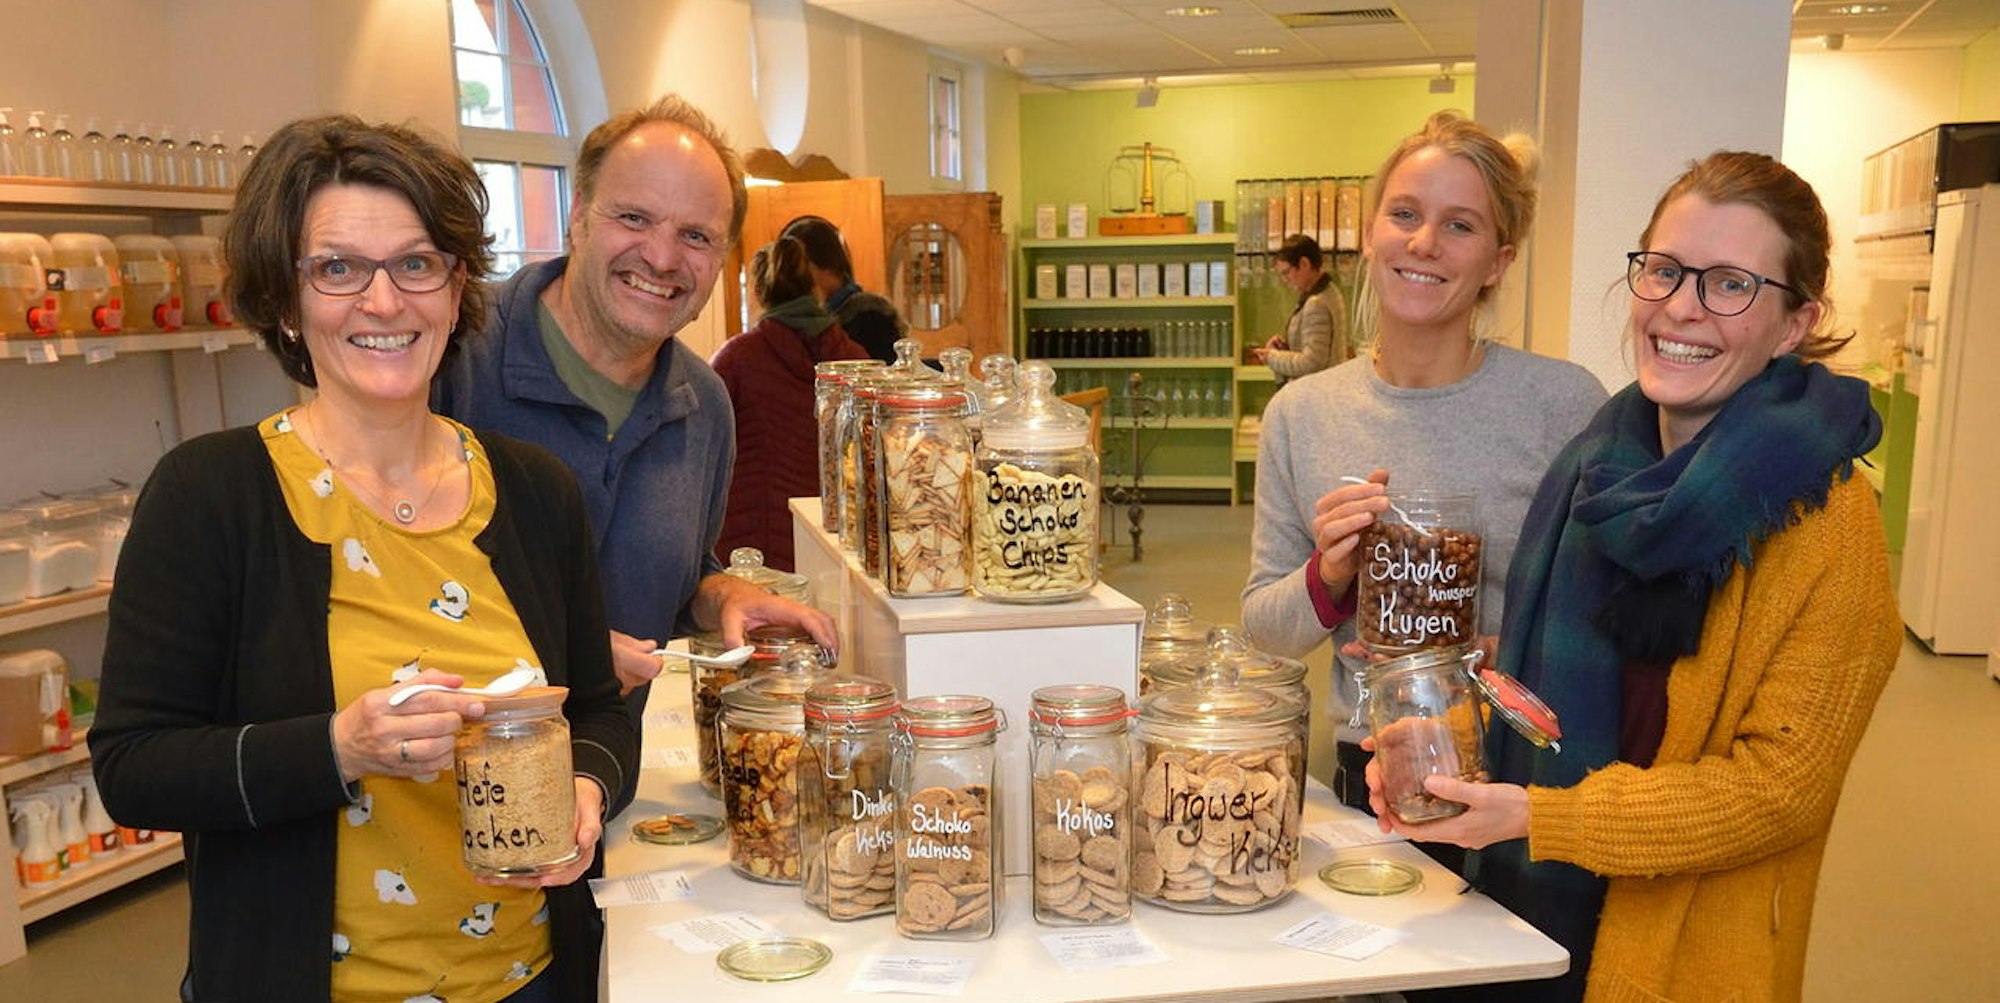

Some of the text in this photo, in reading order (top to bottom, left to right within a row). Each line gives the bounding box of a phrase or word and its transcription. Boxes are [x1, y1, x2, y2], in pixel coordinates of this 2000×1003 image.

[987, 470, 1087, 504] Bananen
[1000, 506, 1079, 535] Schoko
[1003, 541, 1068, 576] Chips
[1368, 543, 1458, 586] Schoko
[1379, 590, 1460, 645] Kugen
[455, 760, 505, 806] Hefe
[911, 803, 971, 834] Schoko
[1056, 797, 1114, 837] Kokos
[1163, 762, 1268, 847] Ingwer
[906, 836, 972, 861] Walnuss
